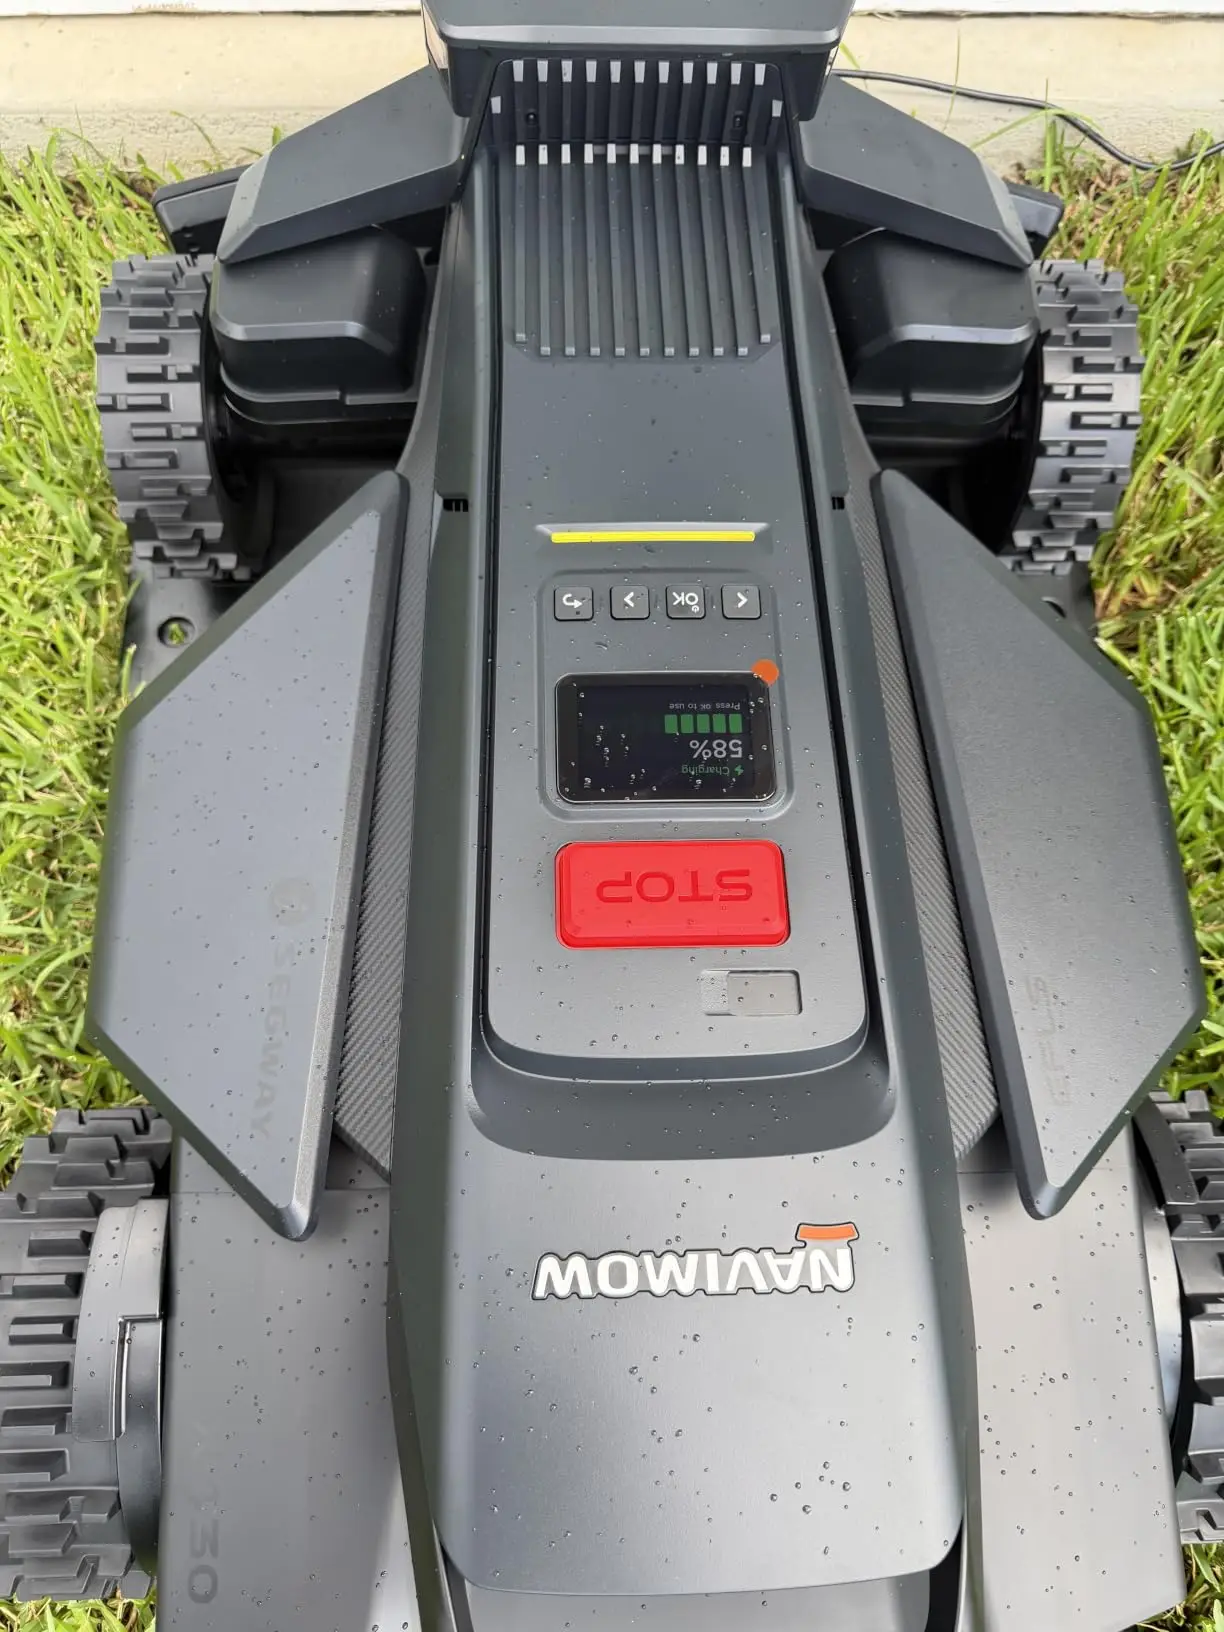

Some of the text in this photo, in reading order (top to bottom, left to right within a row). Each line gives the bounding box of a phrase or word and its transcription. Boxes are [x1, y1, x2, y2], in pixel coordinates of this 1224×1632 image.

[672, 591, 699, 606] OK
[715, 702, 741, 711] Press
[689, 739, 743, 758] 58%
[681, 764, 730, 776] Charging
[596, 869, 753, 903] STOP
[250, 942, 295, 1139] SEGWAY
[533, 1246, 854, 1299] NAVIMOW
